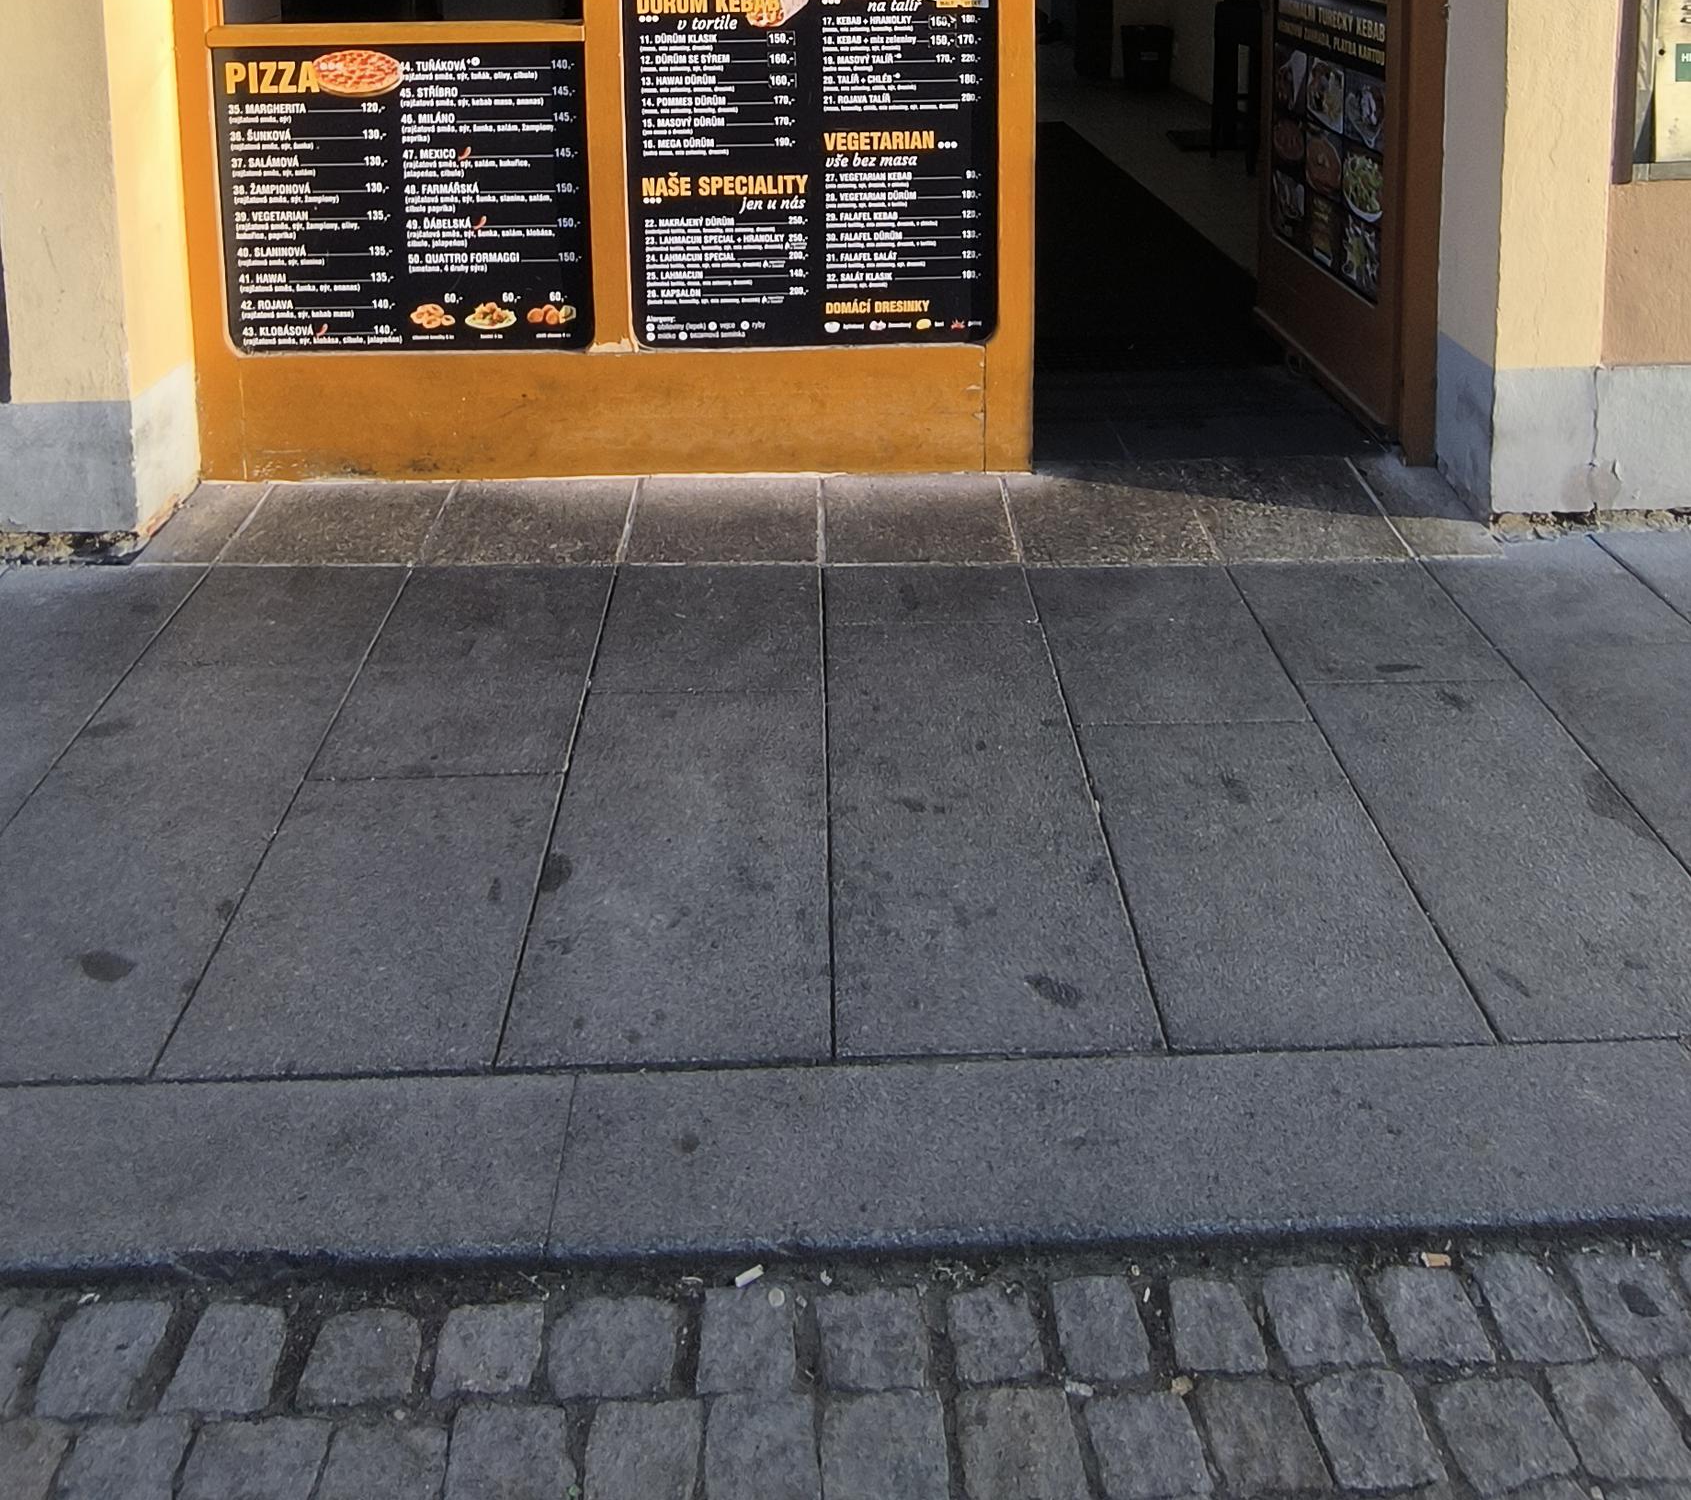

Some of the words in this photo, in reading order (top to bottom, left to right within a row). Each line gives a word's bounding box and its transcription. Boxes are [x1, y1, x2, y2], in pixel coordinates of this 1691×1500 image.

[867, 2, 885, 12] na
[678, 20, 686, 30] v
[692, 14, 737, 30] tortile
[1356, 17, 1385, 42] KEBAB
[640, 35, 652, 44] 11.
[688, 34, 717, 43] KLASIK
[641, 55, 653, 64] 12.
[688, 55, 699, 63] SE
[701, 52, 730, 63] SÝREM
[416, 59, 466, 71] TUŇÁKOVÁ
[552, 59, 574, 70] 140,-
[225, 61, 320, 94] PIZZA
[400, 88, 415, 98] 45.
[552, 86, 575, 97] 145,-
[824, 96, 835, 104] 21.
[838, 95, 867, 104] ROJAVA
[228, 105, 242, 114] 35.
[245, 103, 306, 114] MARGHERITA
[361, 102, 385, 113] 120,-
[418, 112, 455, 123] MILÁNO
[553, 112, 576, 123] 145,-
[247, 129, 291, 141] ŠUNKOVÁ
[363, 129, 387, 140] 130,-
[824, 131, 934, 150] VEGETARIAN
[403, 150, 417, 159] 47.
[420, 149, 456, 159] MEXICO
[555, 148, 578, 158] 145,-
[231, 158, 246, 168] 37.
[249, 155, 299, 167] SALÁMOVÁ
[364, 156, 388, 167] 130,-
[825, 154, 848, 167] vše
[853, 153, 876, 166] bez
[880, 155, 917, 166] masa
[250, 182, 311, 194] ŽAMPIONOVÁ
[366, 182, 389, 193] 130,-
[642, 172, 691, 196] NAŠE
[699, 175, 808, 196] SPECIALITY
[739, 197, 762, 214] jen
[767, 200, 776, 209] u
[781, 195, 805, 209] nás
[252, 211, 309, 221] VEGETARIAN
[367, 211, 391, 222] 135,-
[254, 245, 306, 257] SLANINOVÁ
[704, 253, 735, 261] SPECIAL
[408, 254, 423, 264] 50.
[425, 253, 467, 264] QUATTRO
[470, 252, 519, 263] FORMAGGI
[826, 254, 838, 262] 31.
[840, 253, 872, 261] FALAFEL
[239, 274, 253, 283] 41.
[256, 274, 286, 283] HAWAI
[826, 273, 839, 282] 32.
[866, 272, 892, 281] KLASIK
[444, 293, 463, 303] 60,-
[502, 292, 521, 303] 60,-
[550, 292, 567, 302] 60,-
[241, 301, 255, 310] 42.
[258, 300, 293, 310] ROJAVA
[372, 299, 395, 310] 140,-
[826, 299, 871, 314] DOMÁCÍ
[875, 300, 929, 313] DRESINKY
[260, 324, 313, 336] KLOBÁSOVÁ
[374, 325, 396, 336] 140,-
